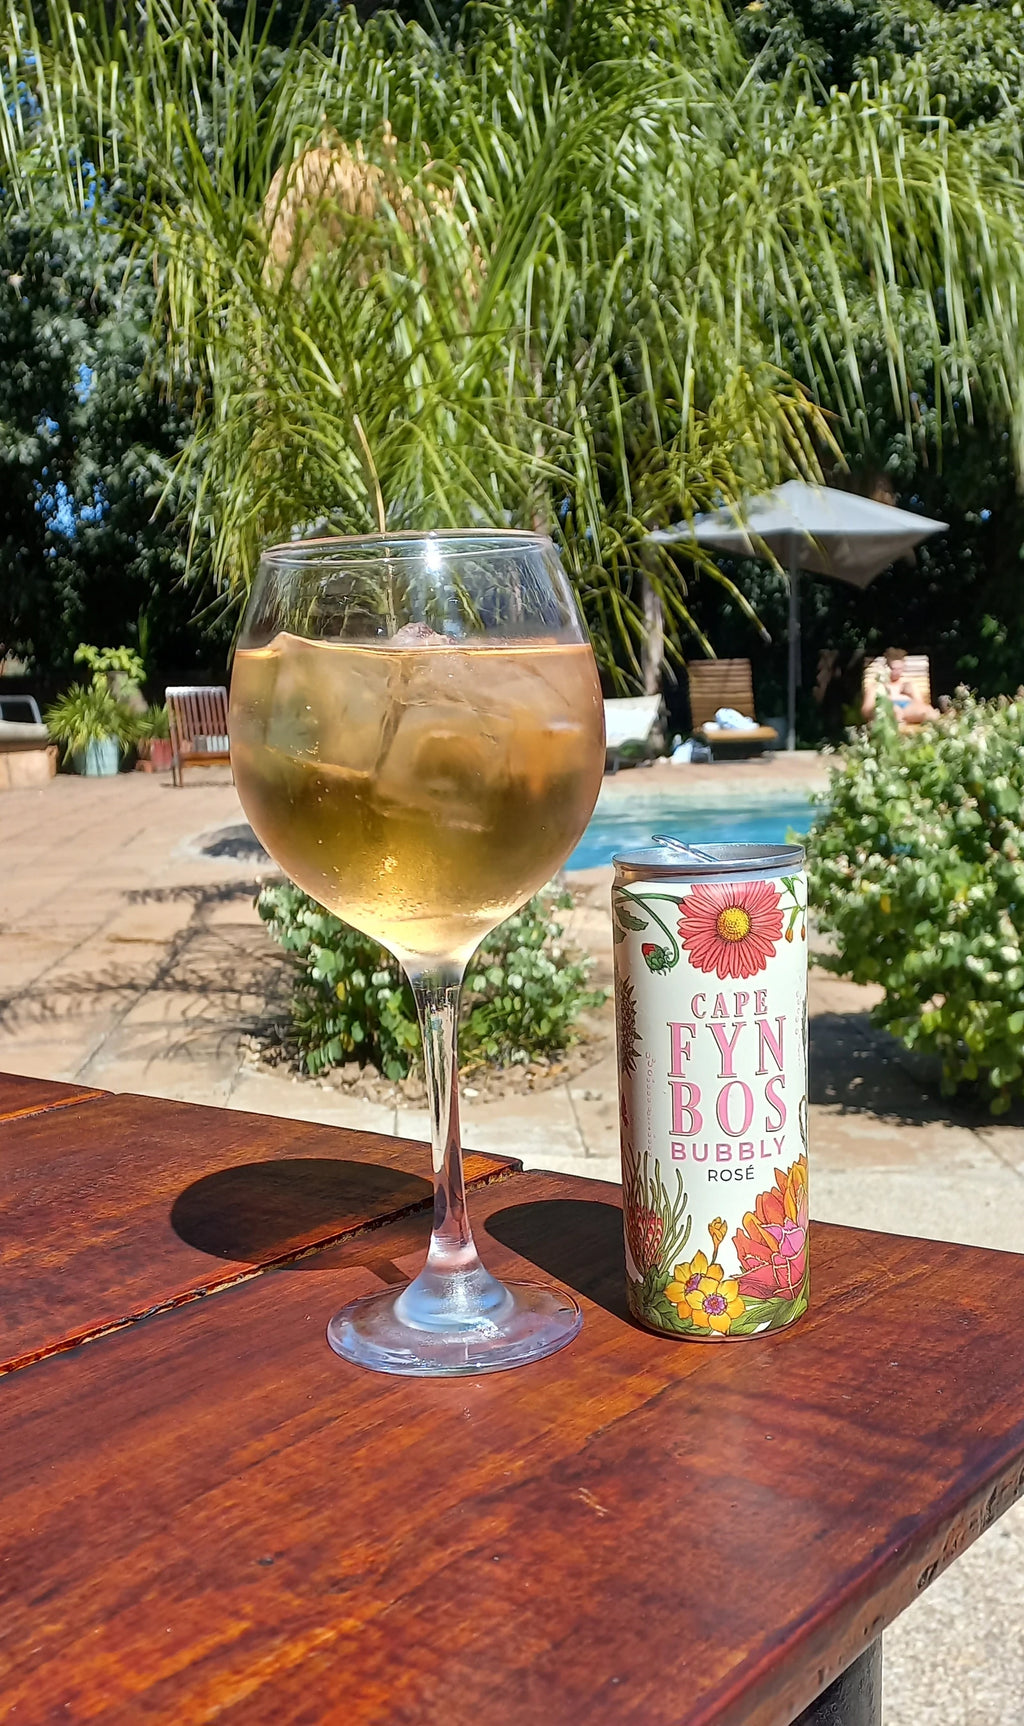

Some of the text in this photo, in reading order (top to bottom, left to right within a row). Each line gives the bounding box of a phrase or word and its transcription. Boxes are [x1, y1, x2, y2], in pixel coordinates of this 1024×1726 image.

[691, 988, 768, 1019] CAPE
[667, 1015, 787, 1078] FYN
[667, 1074, 787, 1137] BOS
[671, 1135, 786, 1162] BUBBLY
[708, 1165, 755, 1182] ROSÉ
